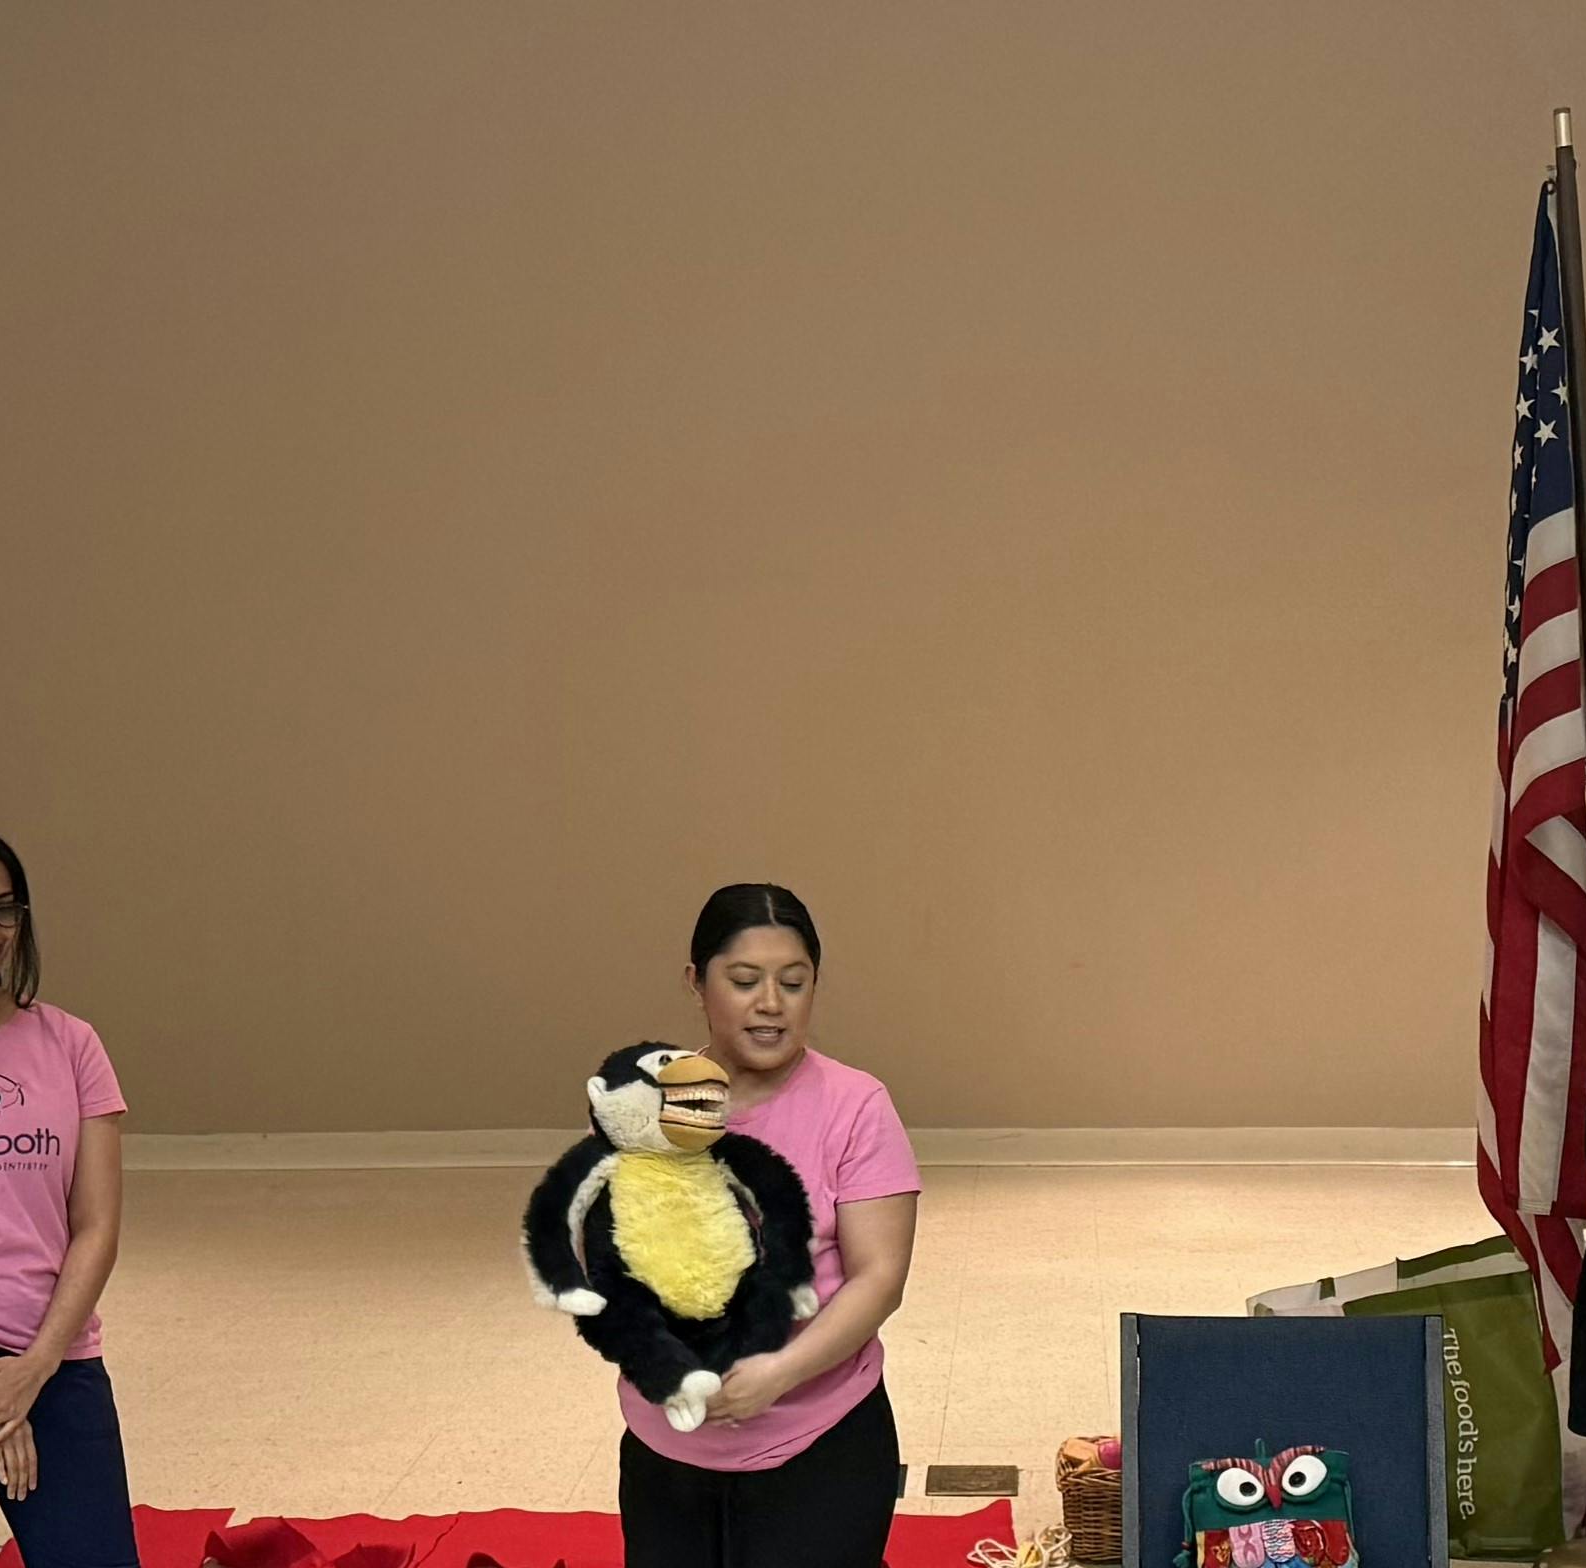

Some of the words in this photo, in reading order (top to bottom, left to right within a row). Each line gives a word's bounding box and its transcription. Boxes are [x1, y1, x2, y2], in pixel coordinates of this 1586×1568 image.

[1443, 1328, 1462, 1376] The
[1451, 1377, 1479, 1453] food's
[1456, 1456, 1478, 1520] here.
